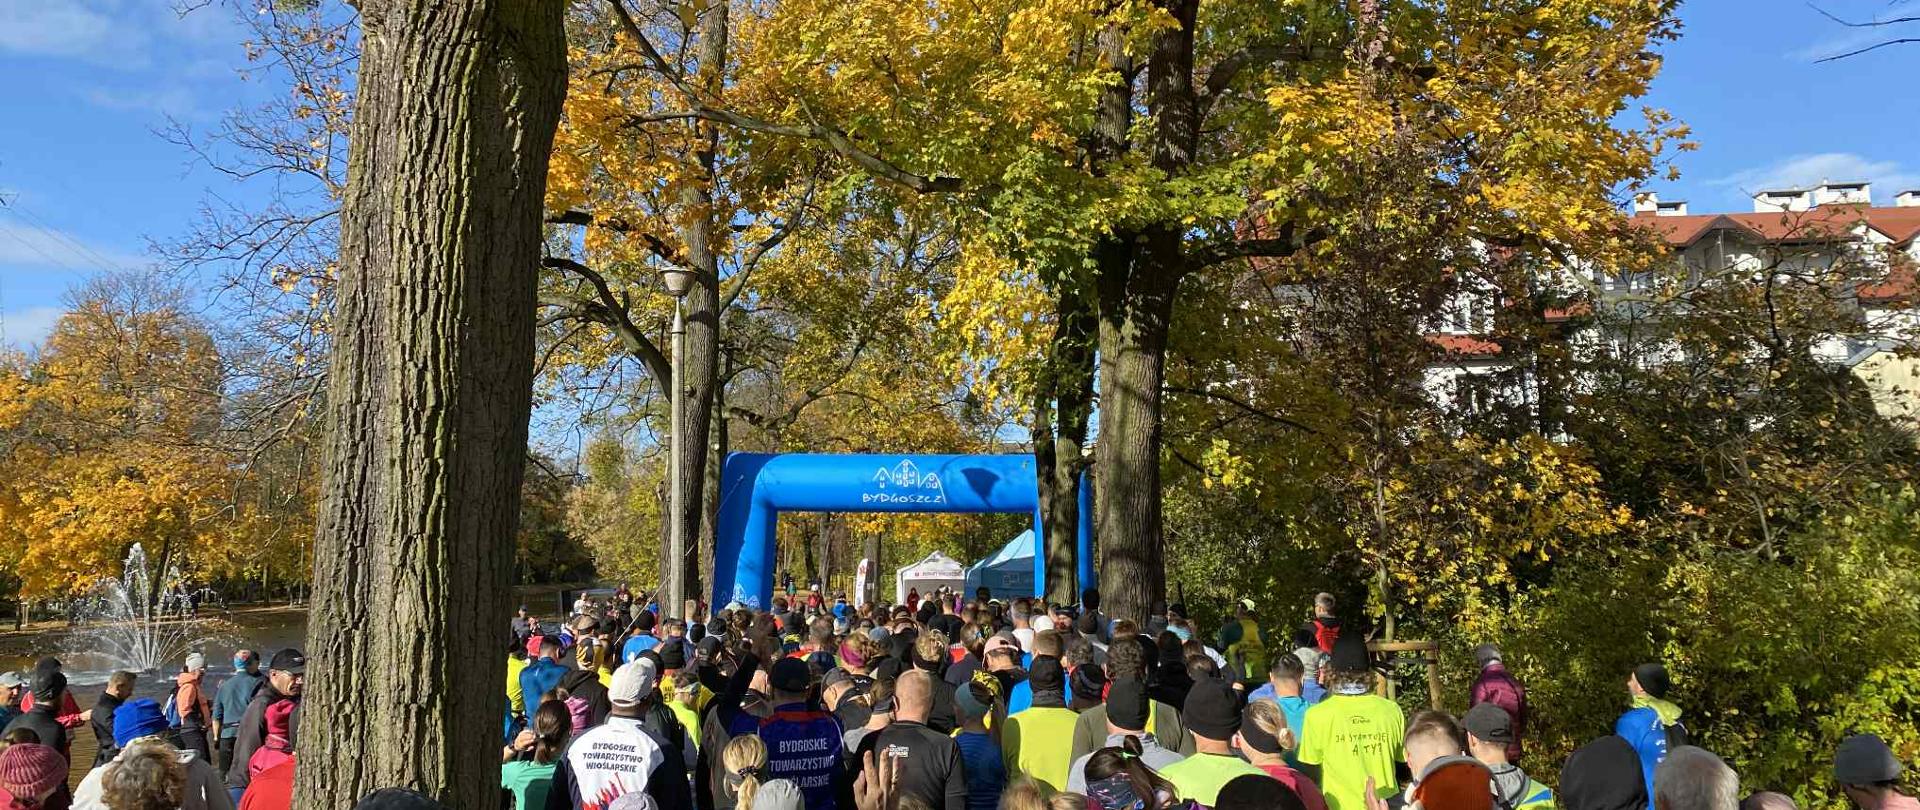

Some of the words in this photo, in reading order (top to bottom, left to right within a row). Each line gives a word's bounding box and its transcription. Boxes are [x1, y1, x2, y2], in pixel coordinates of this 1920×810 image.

[862, 492, 943, 503] BYDGOSZCZ
[592, 742, 636, 752] BYDGOSKIE
[779, 737, 828, 753] BYDGOSKIE
[1352, 743, 1359, 755] A
[582, 752, 643, 763] TOWARZYSTWO
[769, 755, 834, 772] TOWARZYSTWO
[586, 761, 637, 773] WIOŚLARSKIE
